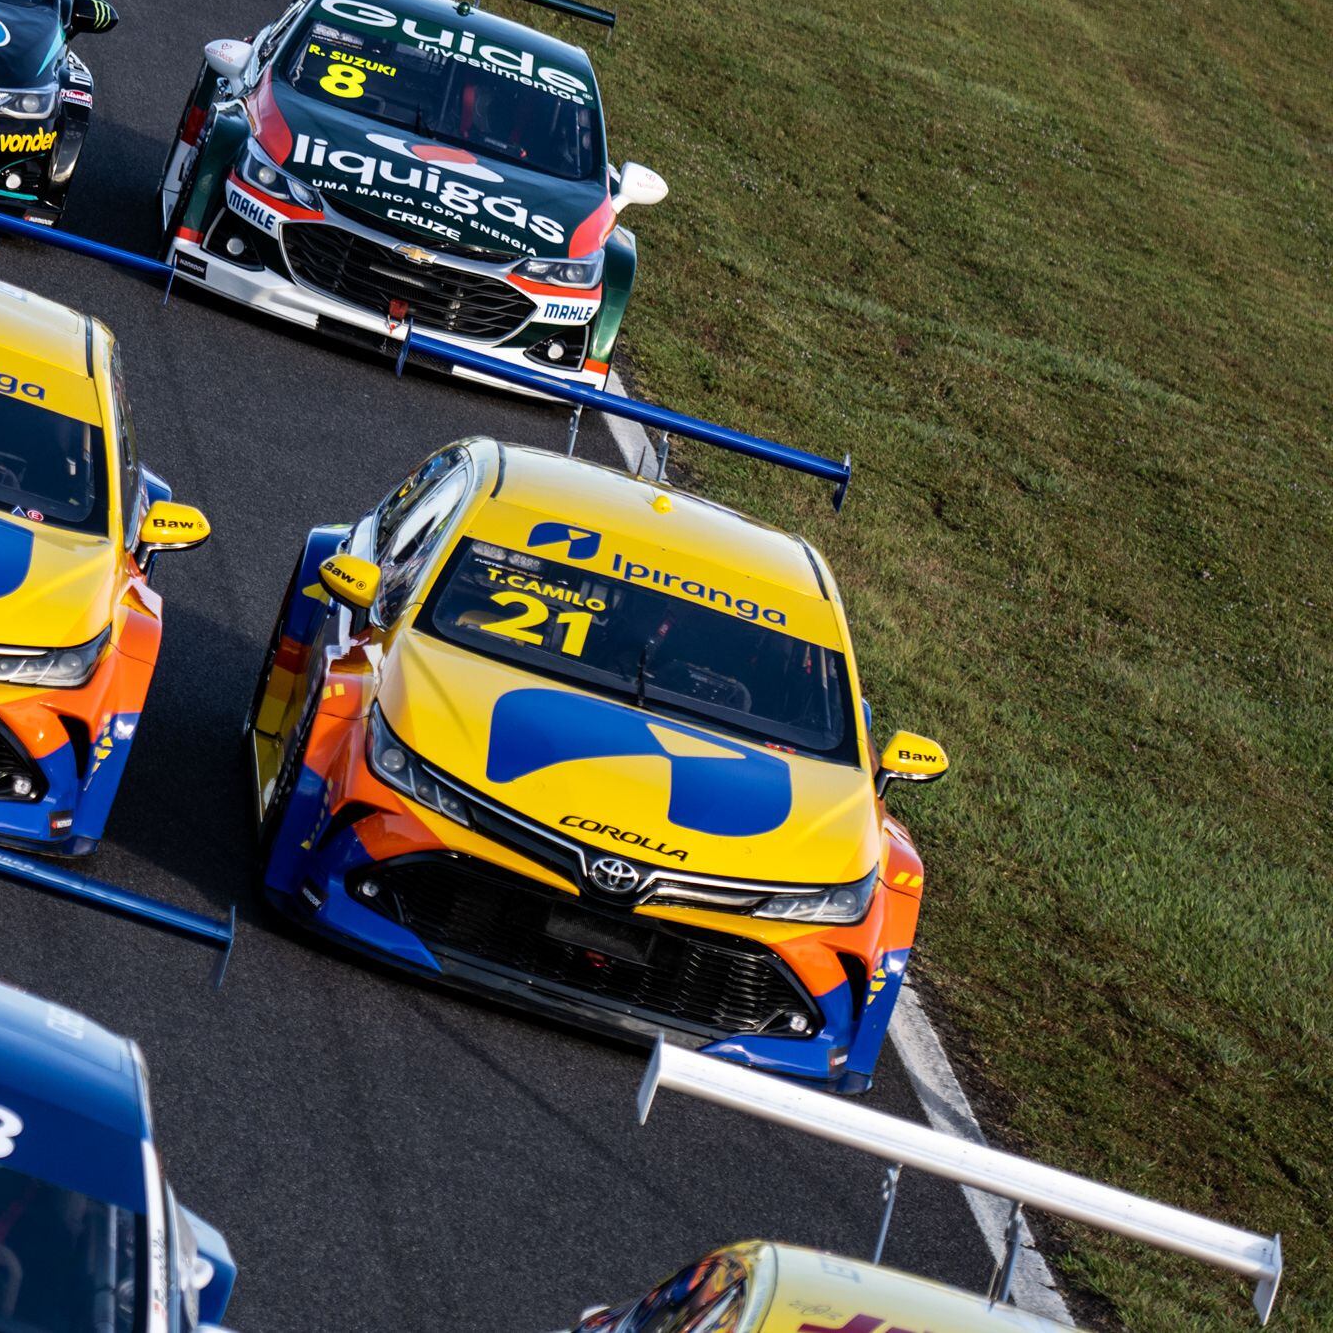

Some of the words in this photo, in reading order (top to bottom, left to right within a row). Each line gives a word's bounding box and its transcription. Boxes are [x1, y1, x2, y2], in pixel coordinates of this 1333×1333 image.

[309, 43, 326, 58] R.
[329, 50, 396, 77] SUZUKI
[319, 63, 367, 99] 8
[419, 40, 586, 106] investimentos
[0, 127, 57, 152] vonder
[228, 190, 276, 230] MAHLE
[293, 134, 565, 245] liquigás
[312, 179, 349, 196] UMA
[355, 185, 417, 208] MARCA
[422, 200, 463, 224] COPA
[470, 220, 537, 256] ENERGIA
[387, 209, 461, 241] CRUZE
[543, 303, 594, 321] MAHLE
[488, 567, 606, 613] T.CAMILO
[613, 552, 787, 628] Ipiranga
[479, 591, 593, 659] 21
[558, 814, 688, 862] COROLLA
